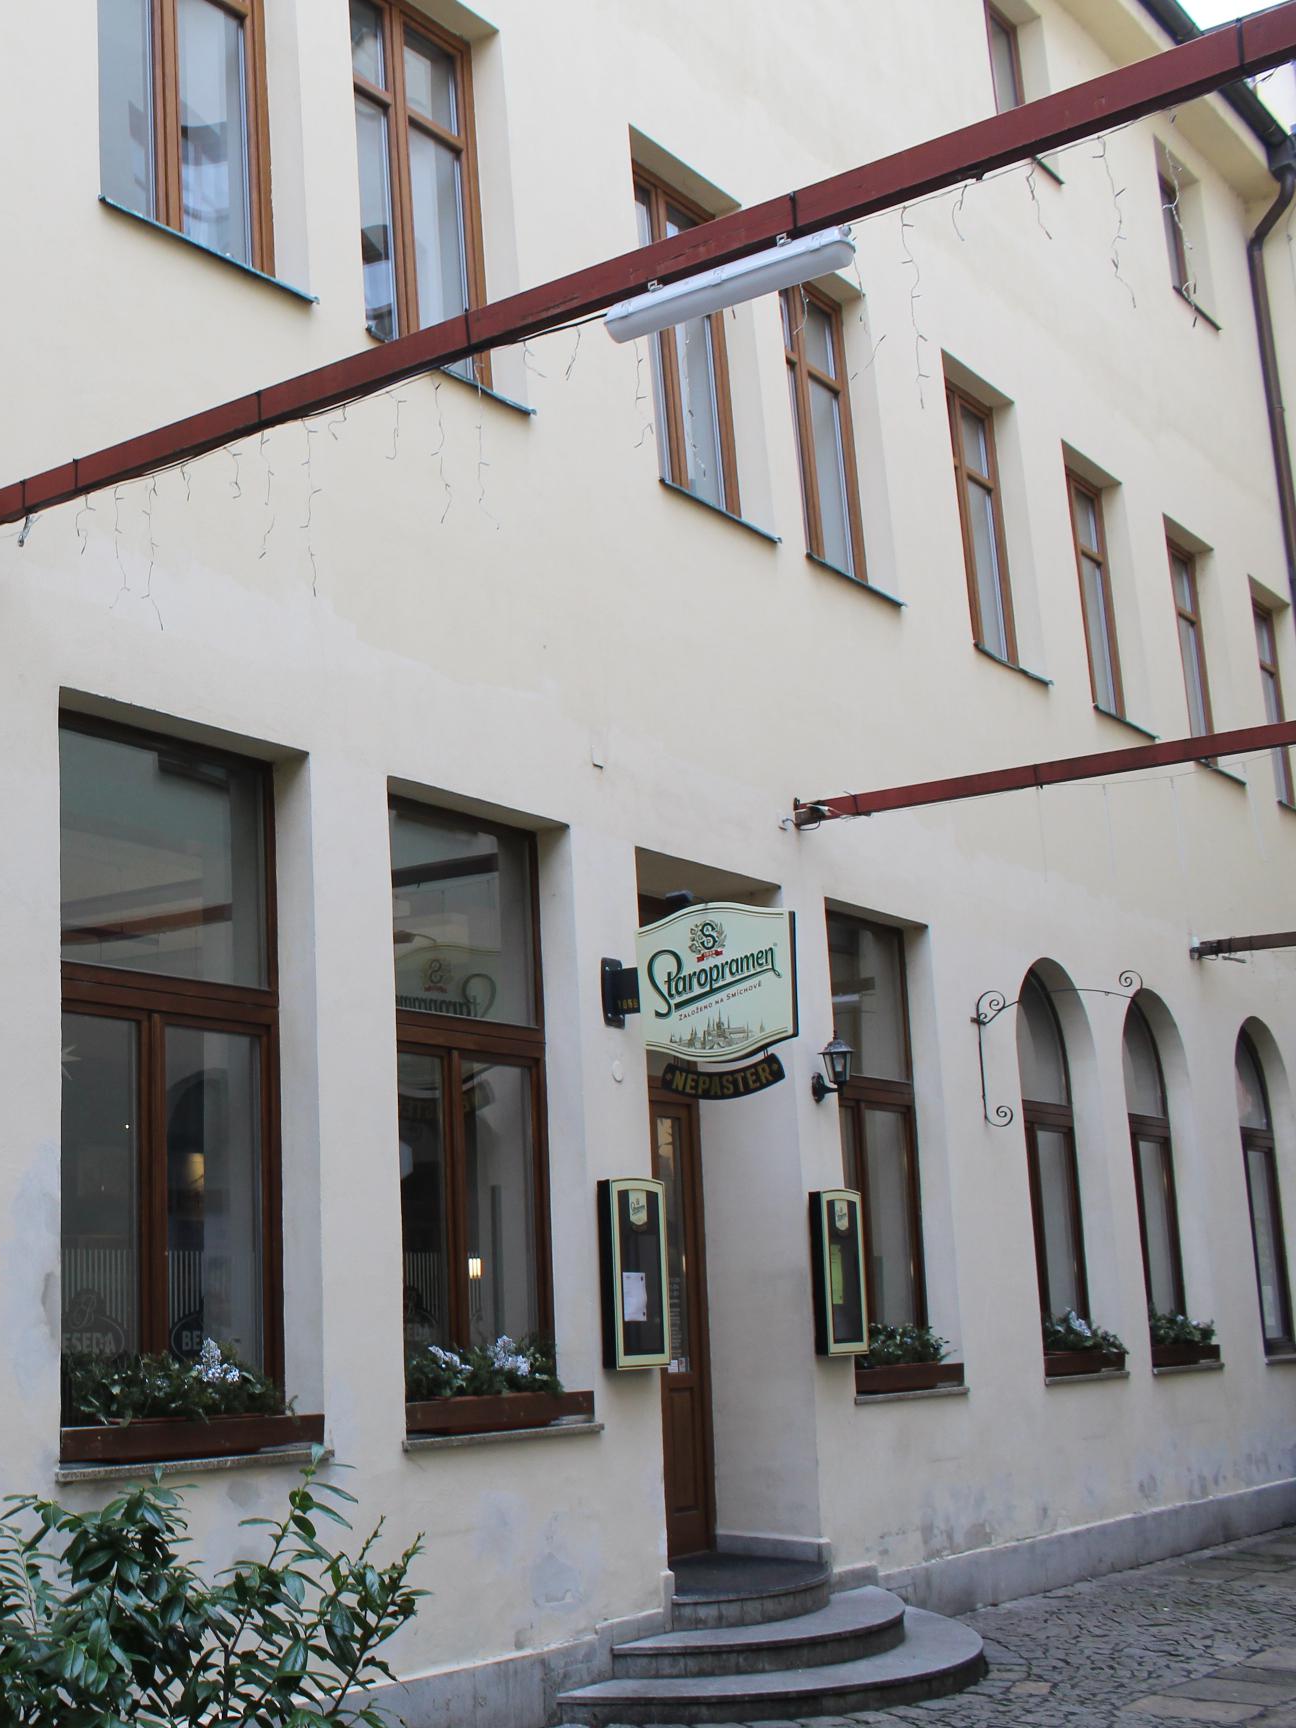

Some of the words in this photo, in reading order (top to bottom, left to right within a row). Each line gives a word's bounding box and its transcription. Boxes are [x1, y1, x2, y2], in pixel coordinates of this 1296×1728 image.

[647, 947, 781, 1019] Staropramen
[672, 1063, 774, 1096] NEPASTER
[61, 1332, 115, 1354] ESEDA
